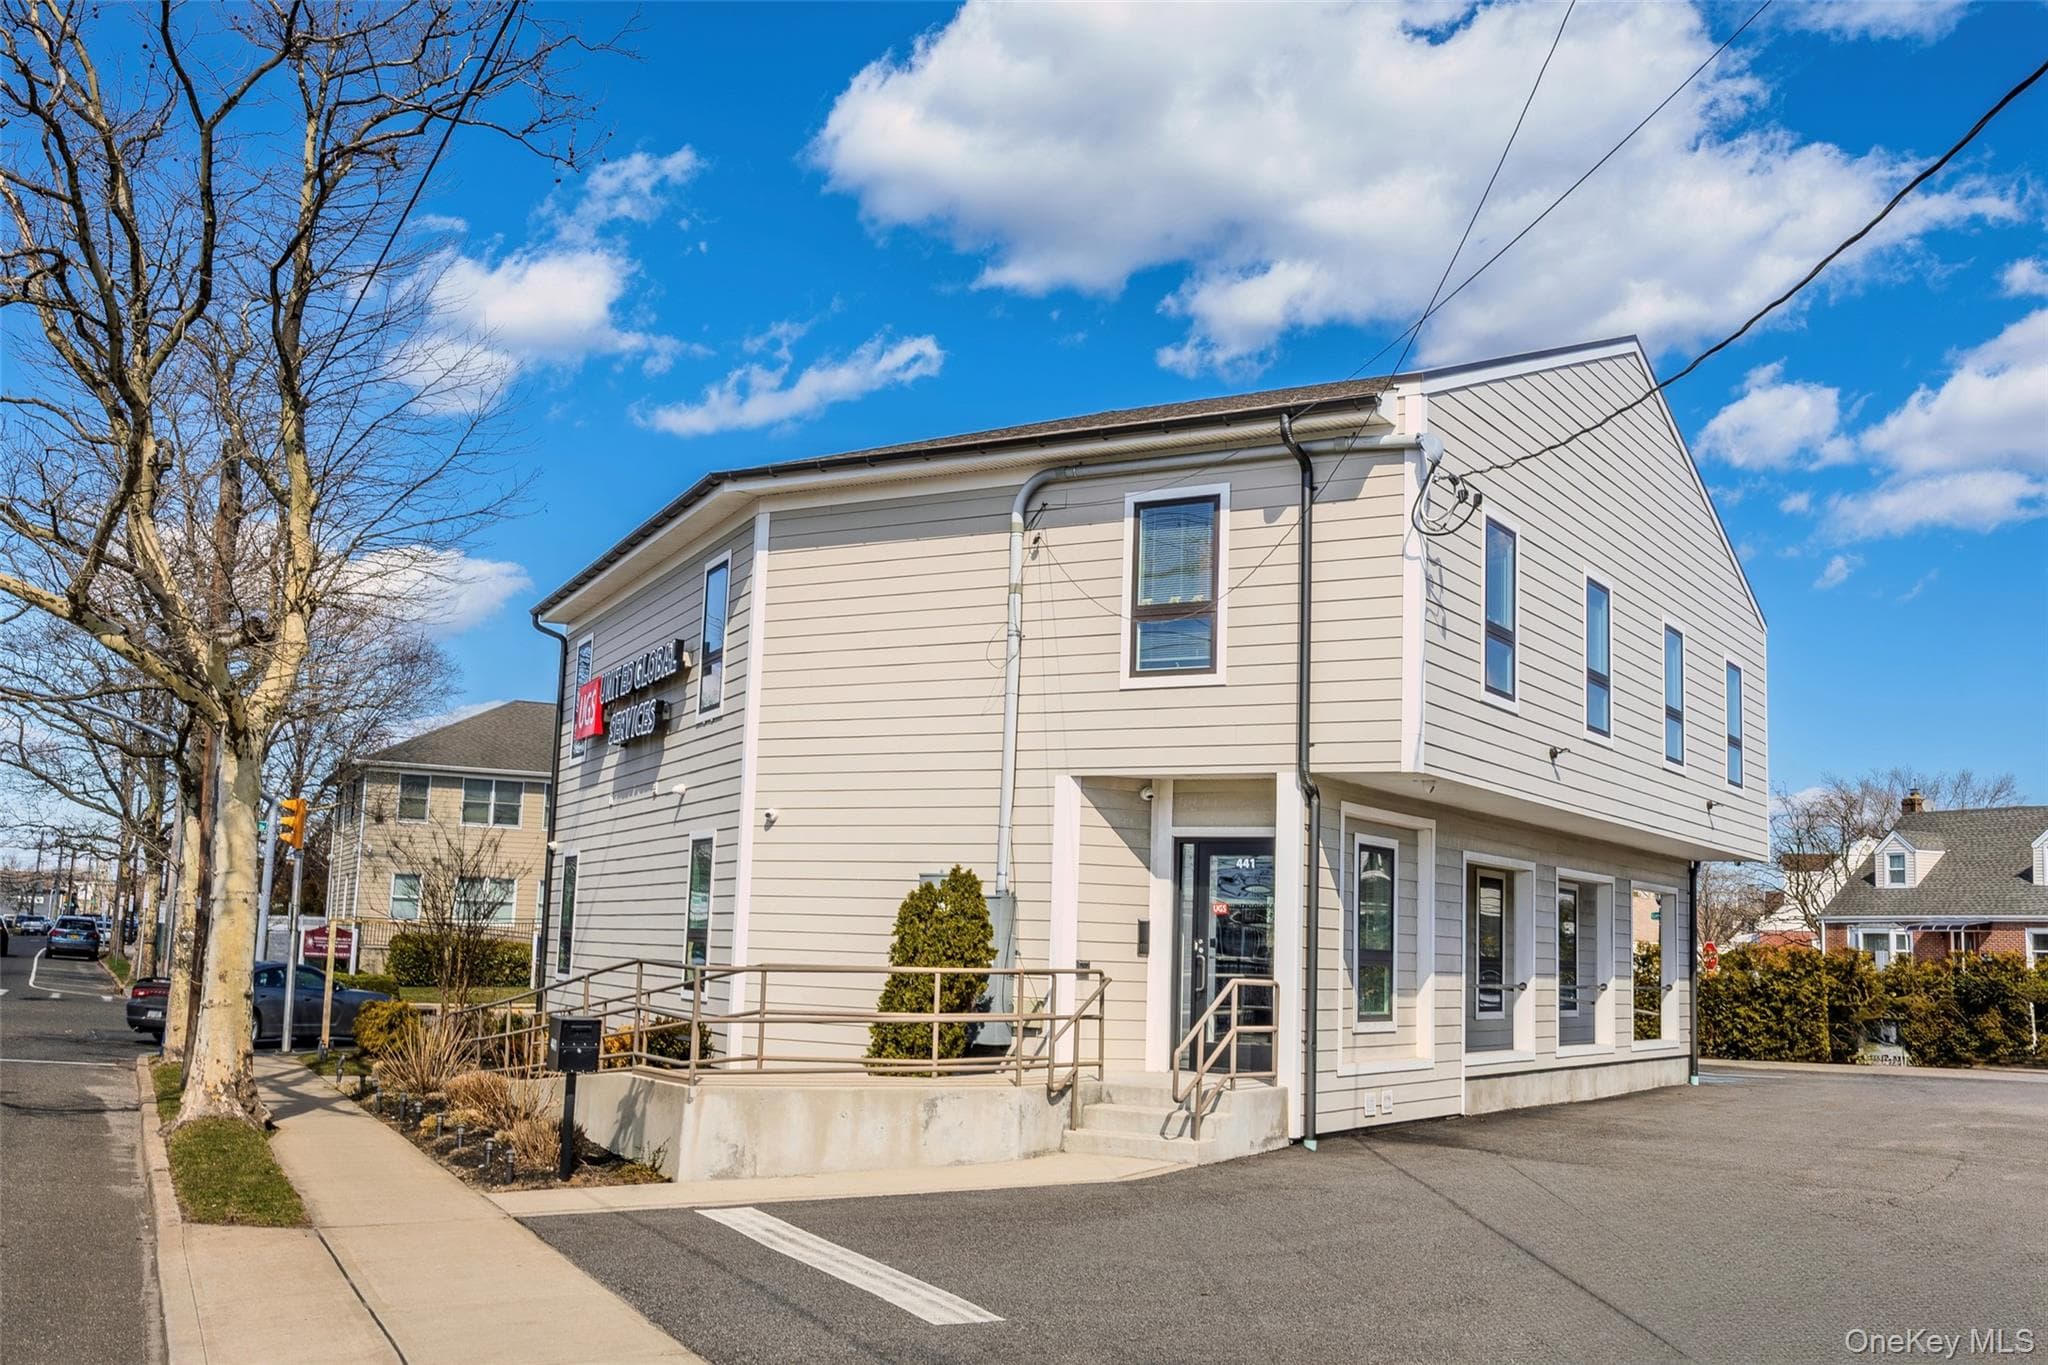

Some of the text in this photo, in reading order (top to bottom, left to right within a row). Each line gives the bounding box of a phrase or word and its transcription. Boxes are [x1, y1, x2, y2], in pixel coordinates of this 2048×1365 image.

[600, 639, 677, 705] UNITED GLOBAL
[607, 698, 657, 746] SERVICES
[1236, 858, 1256, 869] 441
[1212, 903, 1228, 913] UGS
